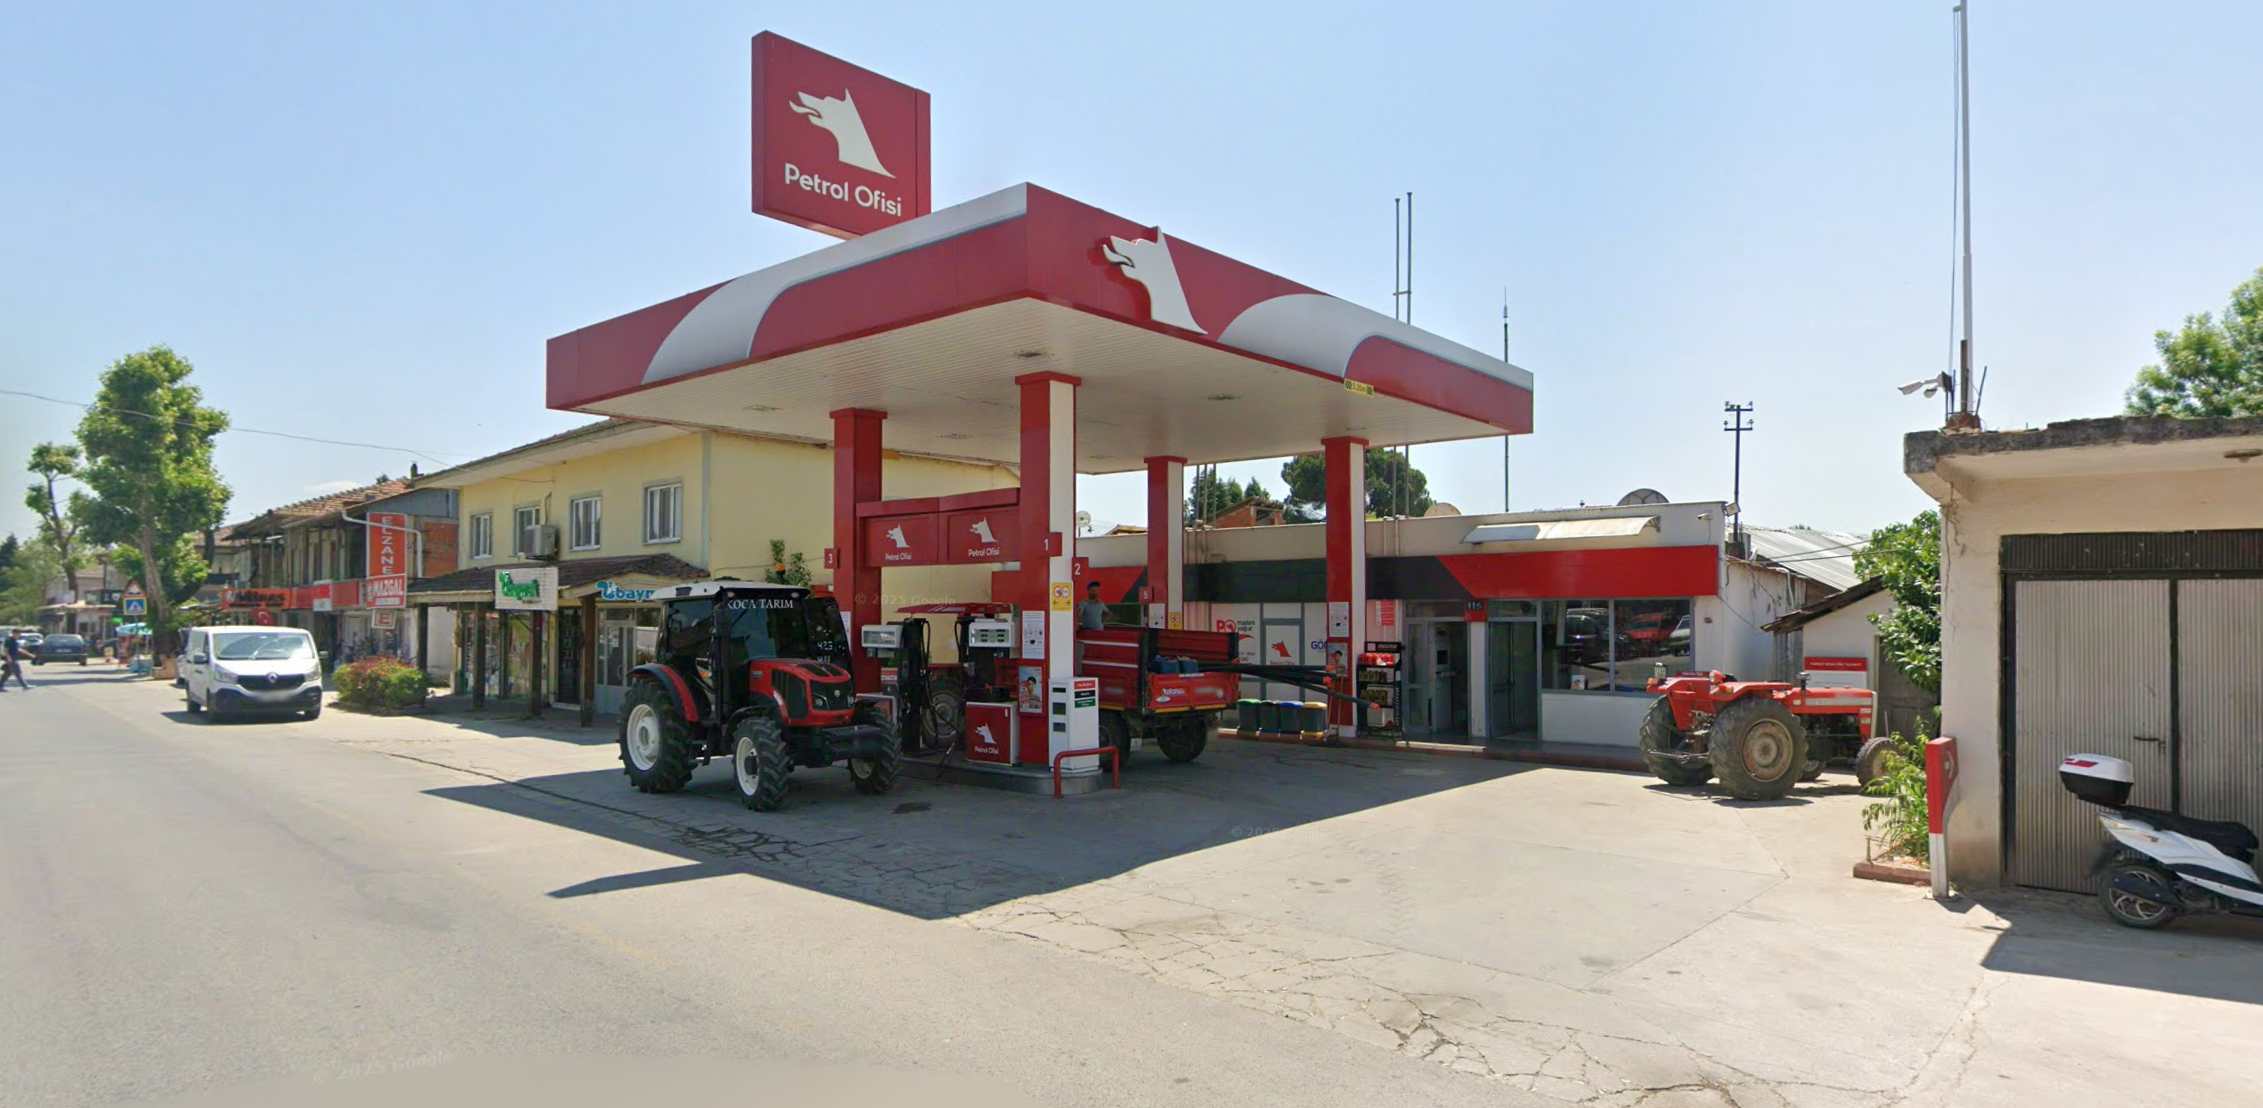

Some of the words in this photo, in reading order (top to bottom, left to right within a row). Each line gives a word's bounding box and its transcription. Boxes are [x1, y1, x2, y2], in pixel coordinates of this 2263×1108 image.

[785, 162, 849, 202] Petrol
[854, 185, 902, 217] Ofisi
[1043, 538, 1049, 551] 1
[885, 553, 900, 561] Petrol
[900, 552, 912, 560] Ofisi
[968, 549, 986, 557] Petrol
[986, 547, 1000, 556] Ofisi
[828, 553, 834, 565] 3
[1074, 563, 1081, 576] 2
[1143, 591, 1149, 600] 5
[758, 599, 794, 609] TARIM
[1467, 601, 1483, 610] 116
[378, 611, 391, 625] E
[974, 745, 987, 754] Petrol
[987, 747, 999, 755] Ofisi
